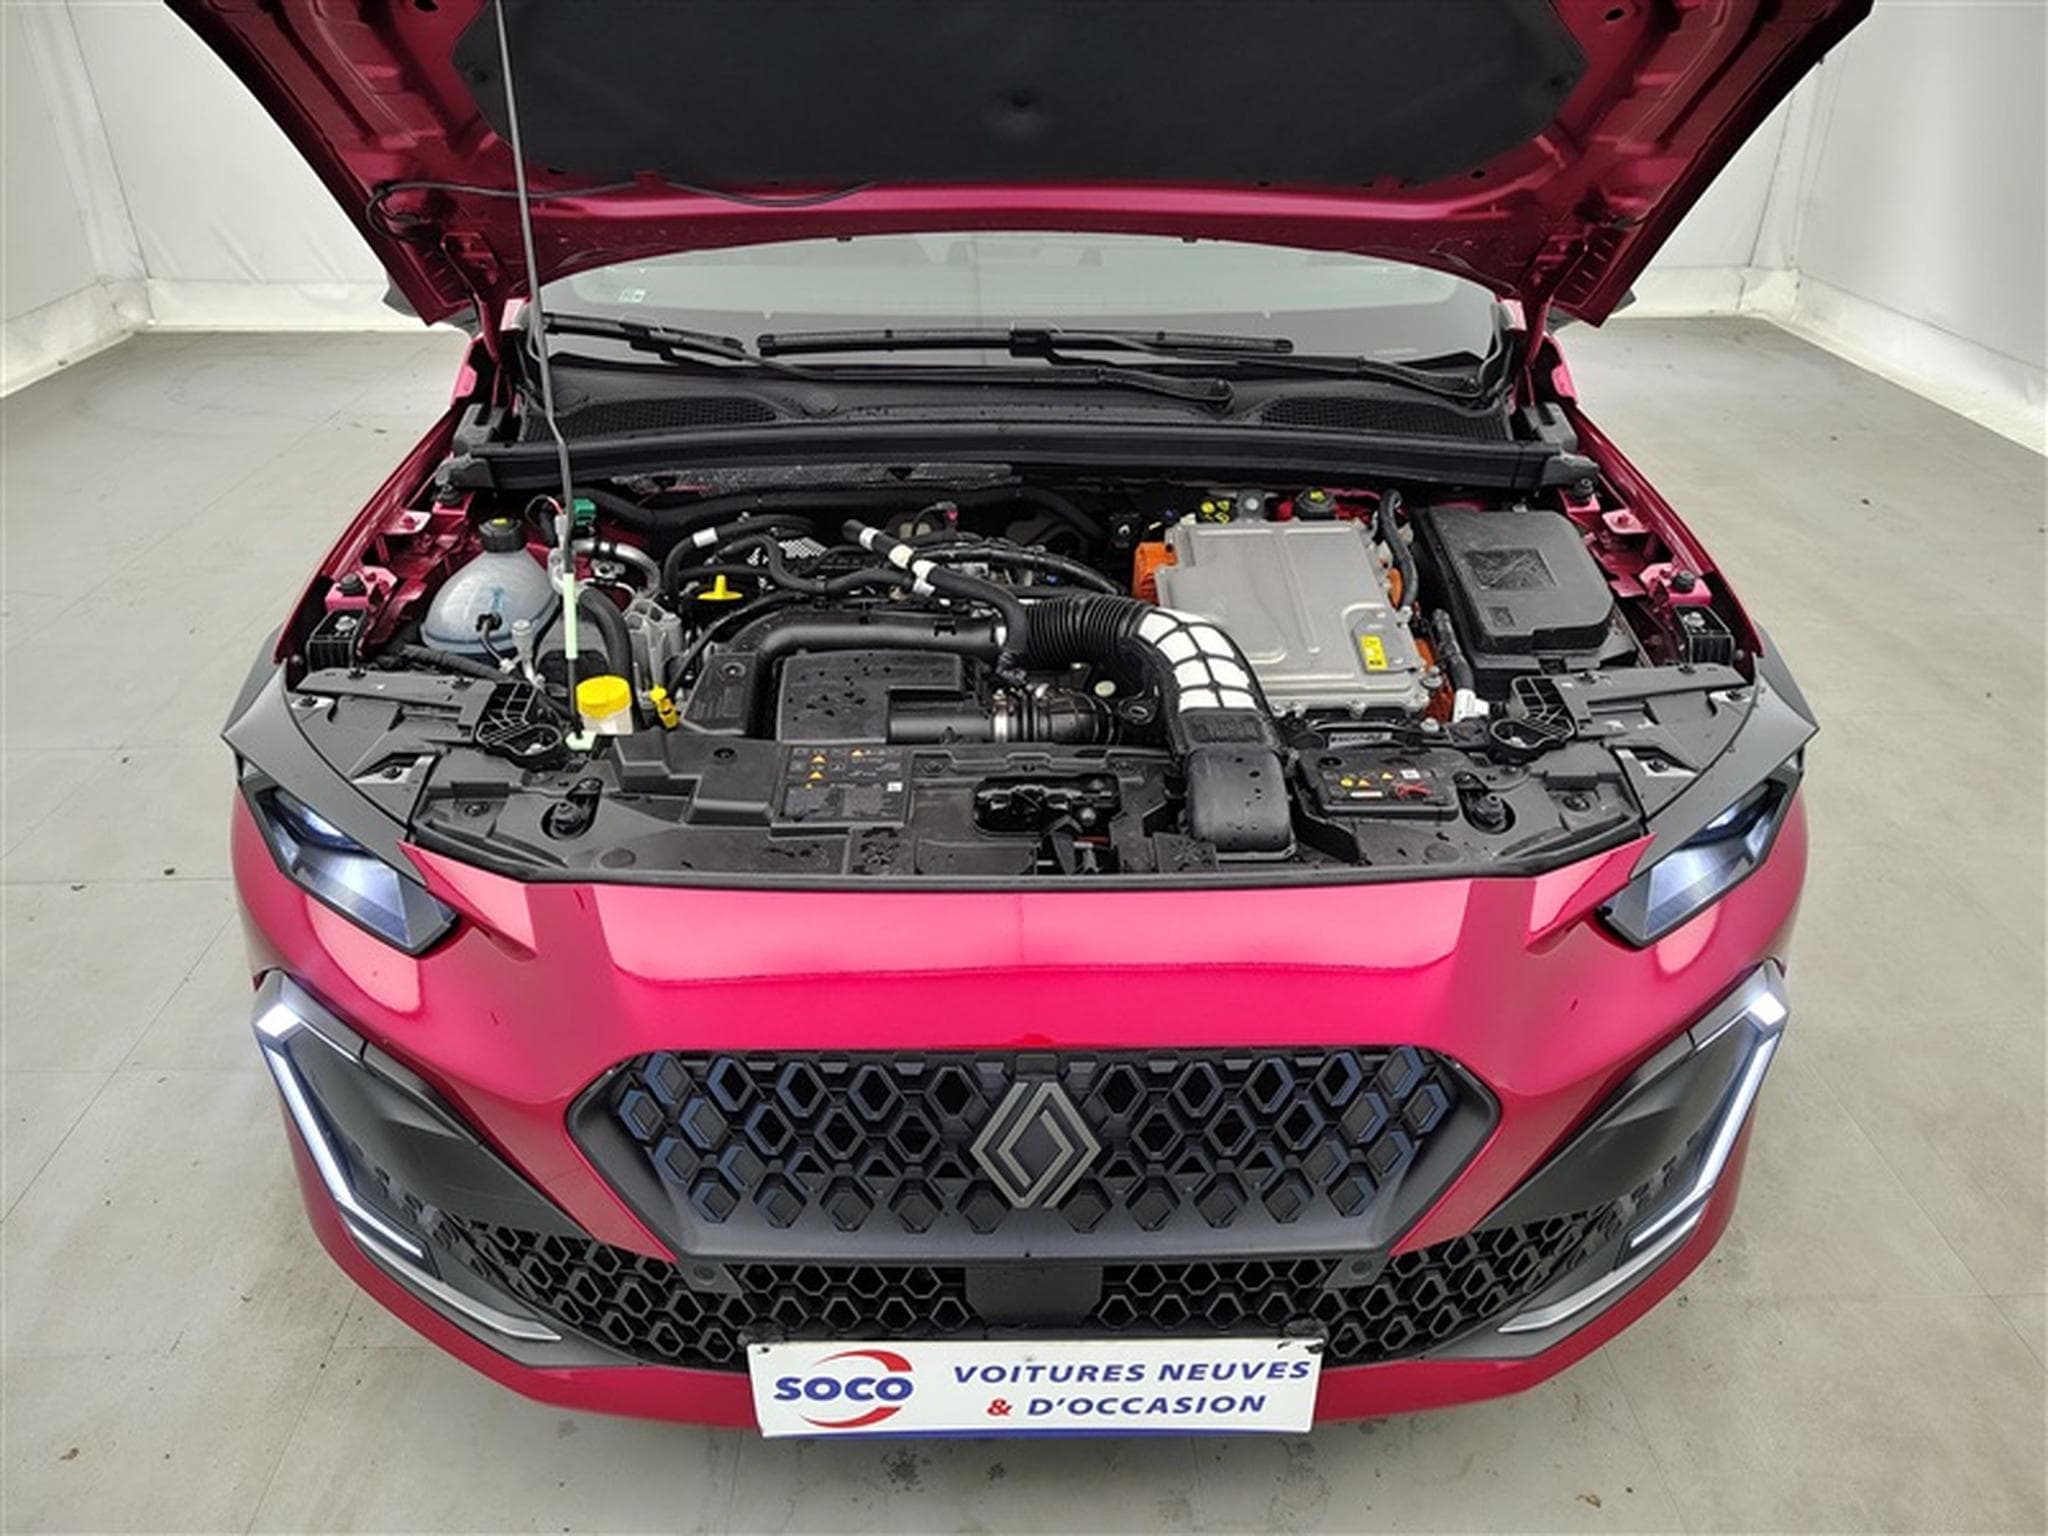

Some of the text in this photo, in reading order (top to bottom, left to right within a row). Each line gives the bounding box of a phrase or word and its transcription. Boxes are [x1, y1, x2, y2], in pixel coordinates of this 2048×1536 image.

[953, 1360, 1311, 1384] VOITURES NEUVES
[773, 1376, 913, 1401] SOCO
[986, 1395, 1267, 1417] & D'OCCASION
